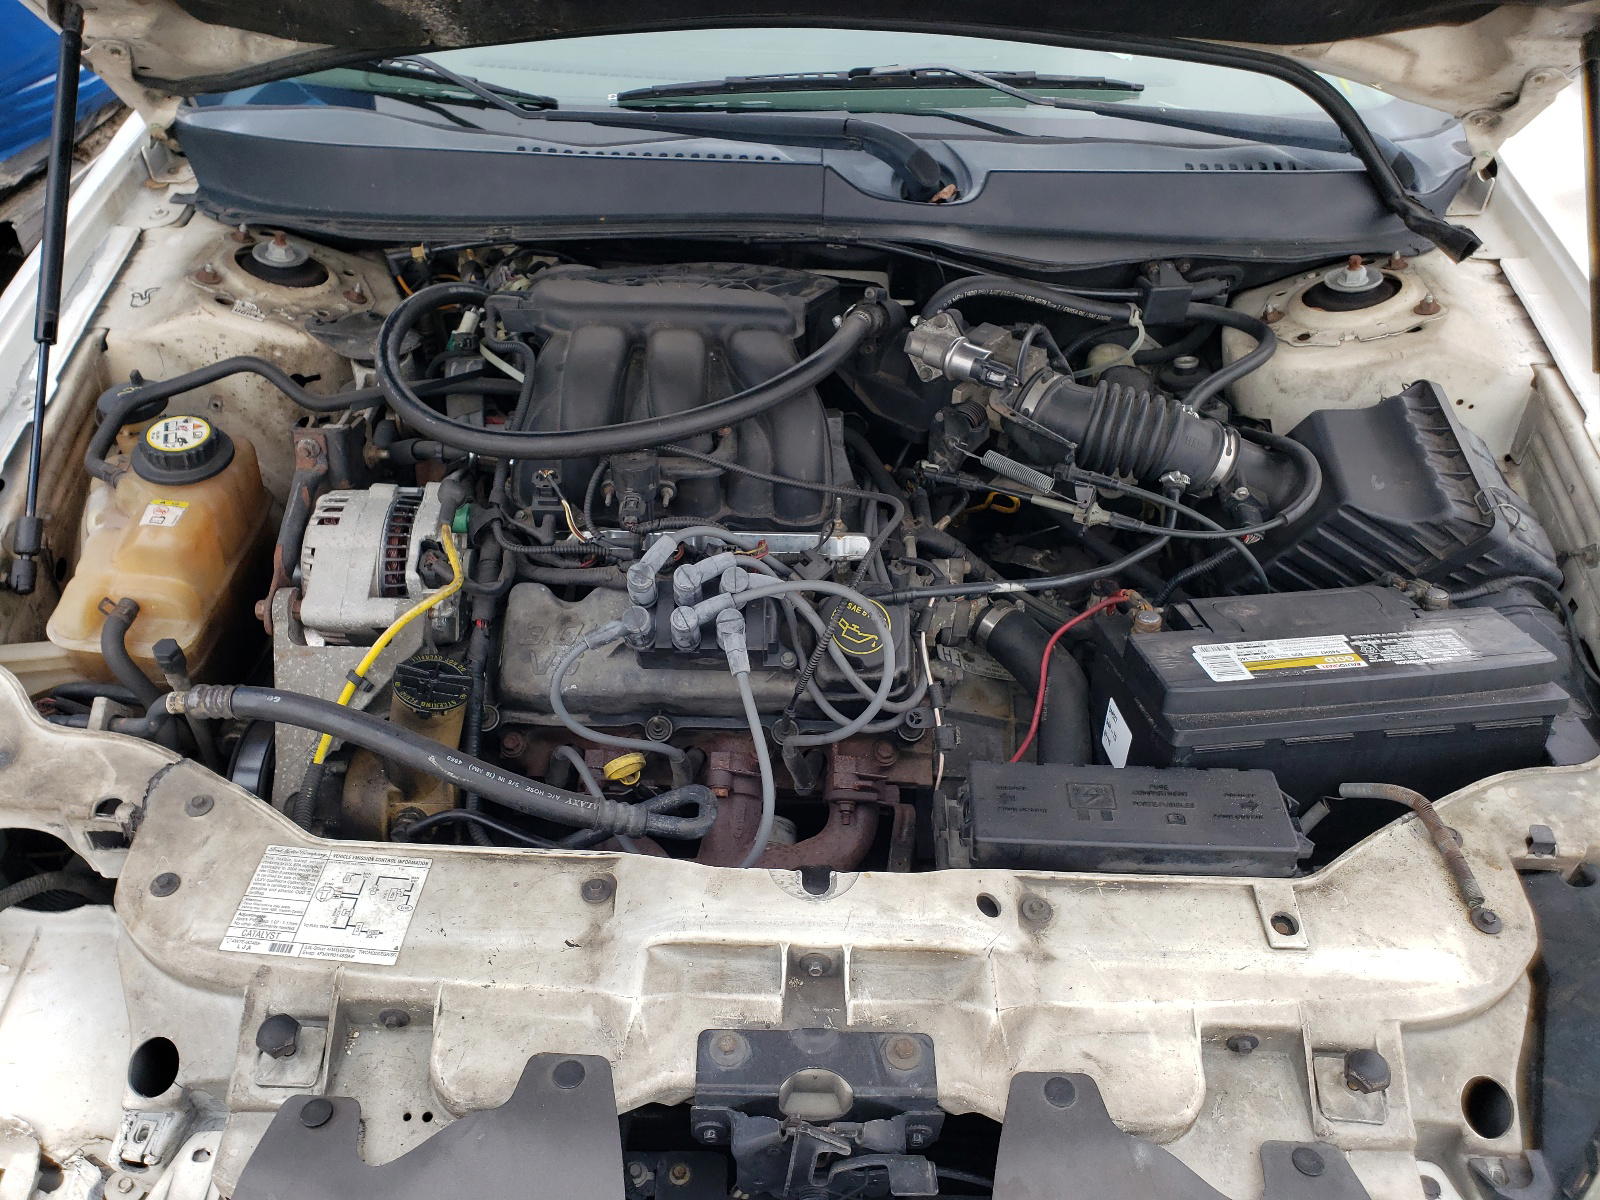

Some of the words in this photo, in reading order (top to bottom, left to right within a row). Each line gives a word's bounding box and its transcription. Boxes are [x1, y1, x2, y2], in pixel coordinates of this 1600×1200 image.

[847, 602, 861, 614] SAE
[1324, 655, 1355, 663] GOLD
[420, 699, 457, 708] STEERING
[525, 784, 545, 796] HOSE
[548, 791, 561, 800] A/C
[397, 858, 429, 866] INFORMATION
[241, 929, 281, 940] CATALYST
